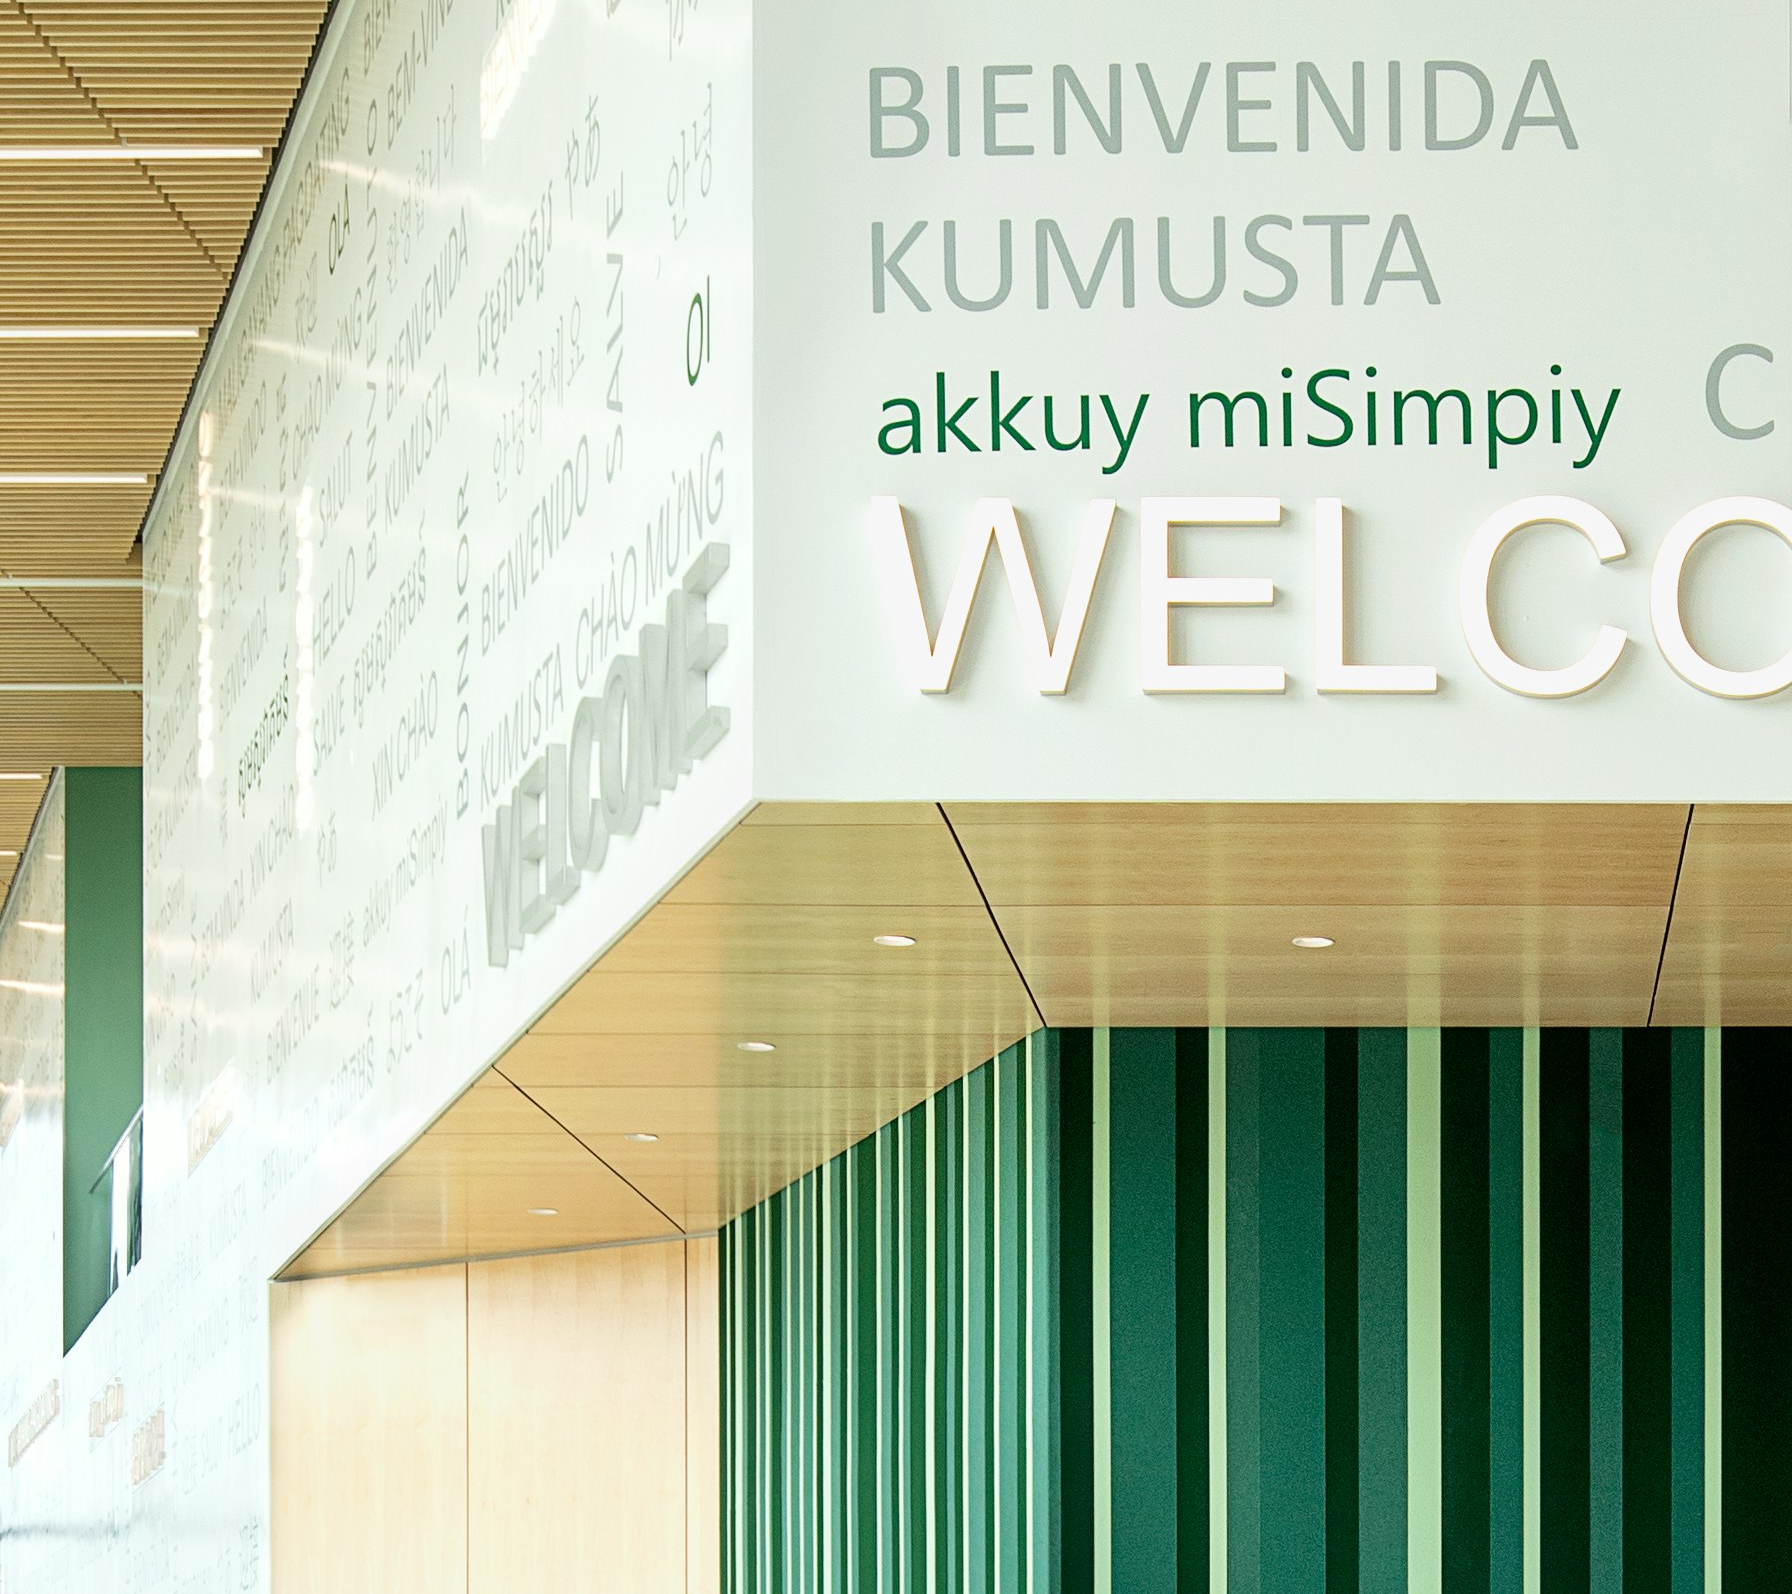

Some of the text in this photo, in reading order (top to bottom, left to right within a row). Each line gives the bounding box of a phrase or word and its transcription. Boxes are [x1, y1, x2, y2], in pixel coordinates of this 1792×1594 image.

[565, 94, 601, 222] やあ
[666, 80, 713, 242] 안녕
[869, 59, 1578, 158] BIENVENIDA
[386, 205, 468, 423] BIENVENIDA
[605, 170, 623, 485] SALVE
[686, 272, 711, 388] OI
[871, 214, 1441, 313] KUMUSTA
[385, 362, 449, 536] KUMUSTA
[876, 365, 1621, 474] akkuy miSimpiy
[312, 544, 355, 678] HELLO
[481, 432, 589, 658] BIENVENIDO
[575, 429, 724, 690] CHÀO MỪNG
[456, 469, 469, 822] BONJOR
[313, 673, 344, 778] SALVE
[371, 669, 437, 823] XIN CHÀO
[480, 641, 563, 813] KUMUSTA
[480, 541, 731, 968] WELCOME
[441, 905, 470, 1016] OLÁ
